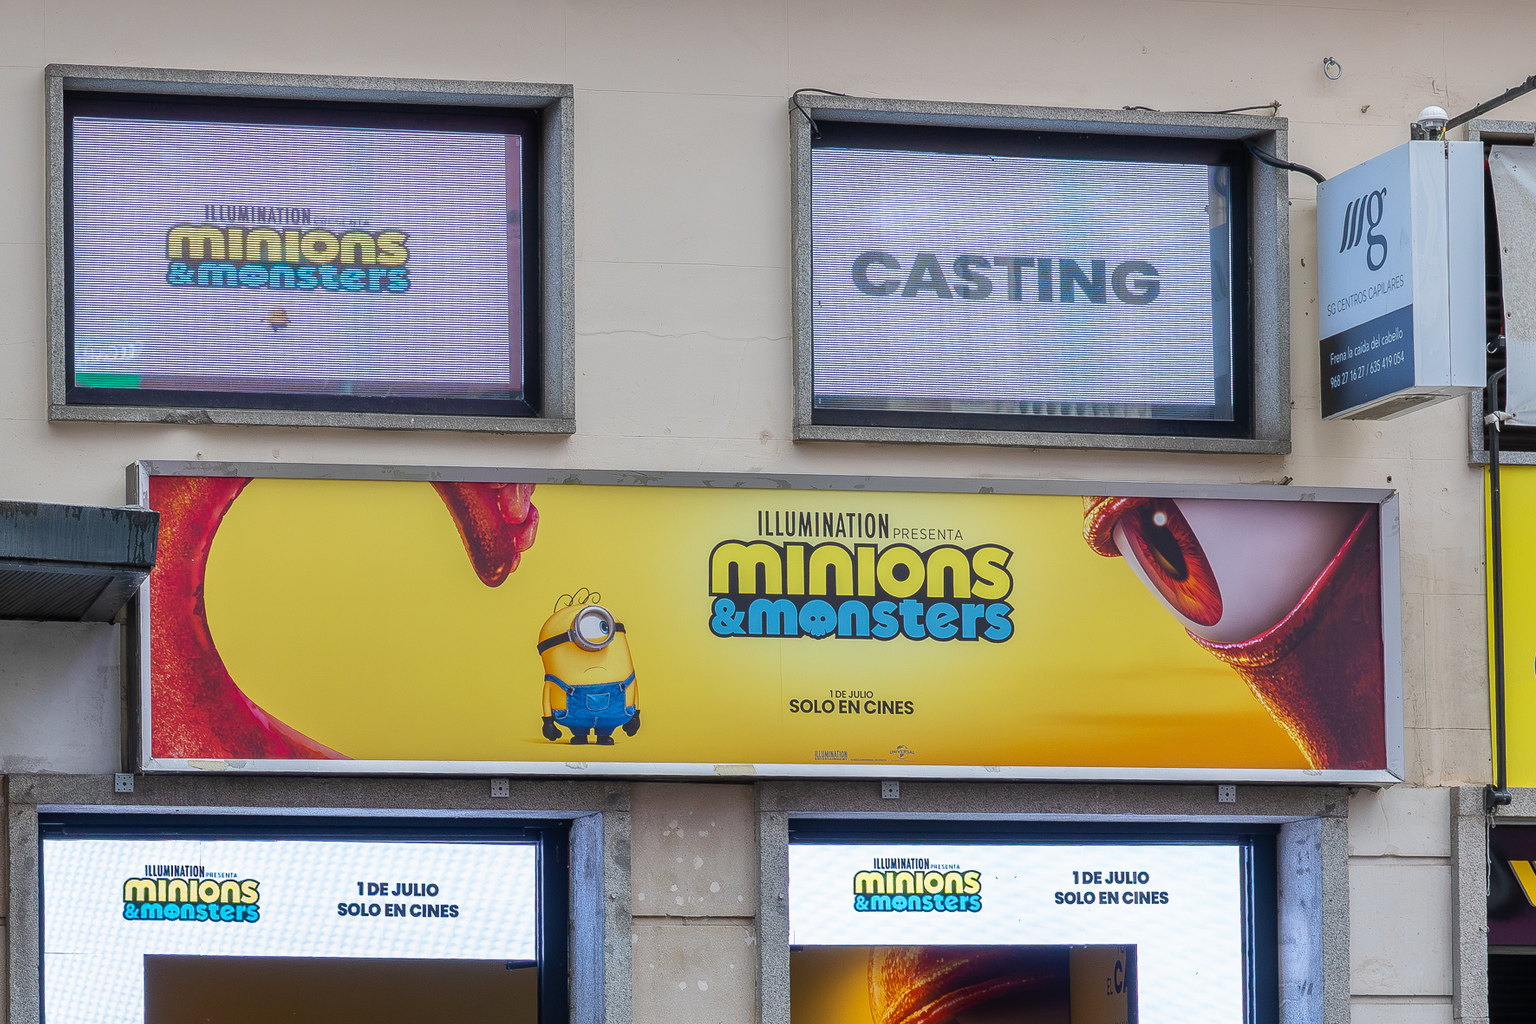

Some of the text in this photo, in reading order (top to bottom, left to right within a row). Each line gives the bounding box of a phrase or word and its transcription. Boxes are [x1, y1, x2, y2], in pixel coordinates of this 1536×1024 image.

[205, 205, 311, 224] ILLUMINATION
[167, 224, 410, 265] minions
[852, 251, 1160, 305] CASTING
[1337, 289, 1367, 313] CENTROS
[1368, 274, 1405, 300] CAPILARES
[1330, 352, 1347, 366] Frena
[1347, 346, 1354, 359] la
[1371, 334, 1381, 350] del
[1381, 327, 1404, 346] cabello
[758, 510, 964, 541] ILLUMINATION PRESENTA
[709, 539, 1014, 602] minions
[709, 597, 1015, 644] &monsters
[835, 690, 847, 699] DE
[848, 690, 874, 699] JULIO
[789, 699, 914, 715] SOLO EN CINES
[145, 864, 205, 878] ILLUMINATION
[873, 858, 930, 870] ILLUMINATION
[853, 869, 982, 896] minions
[1072, 871, 1150, 886] 1 DE JULIO
[123, 877, 260, 904] minions
[357, 881, 439, 898] 1 DE JULIO
[1054, 891, 1169, 906] SOLO EN CINES
[123, 901, 260, 923] &monsters
[337, 902, 459, 919] SOLO EN CINES
[853, 893, 982, 913] &monsters
